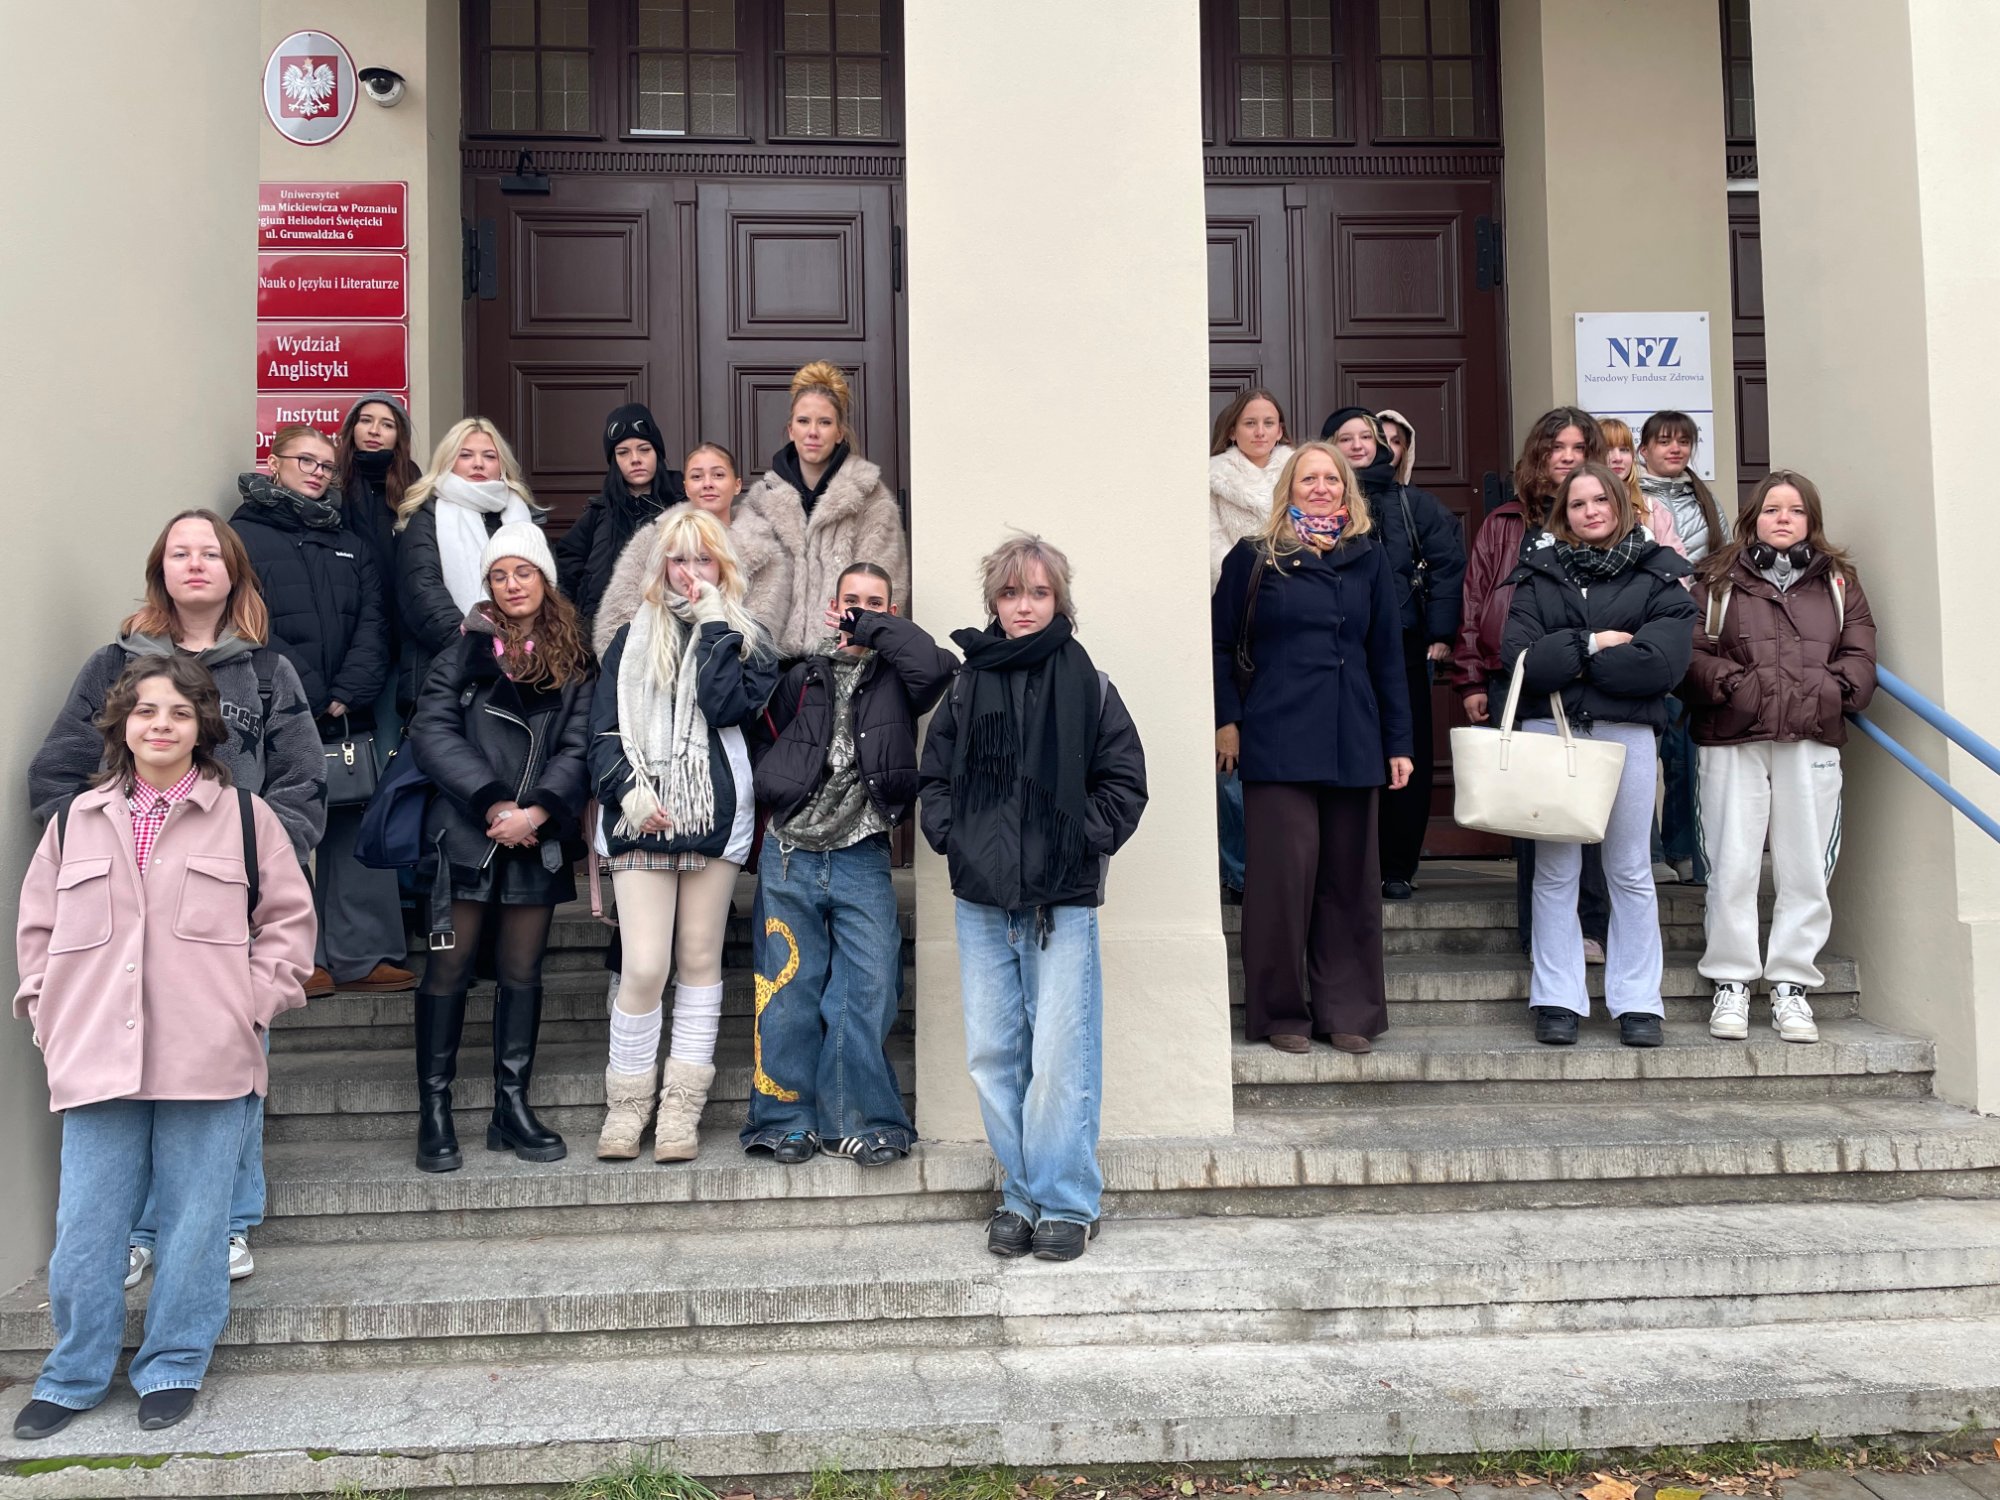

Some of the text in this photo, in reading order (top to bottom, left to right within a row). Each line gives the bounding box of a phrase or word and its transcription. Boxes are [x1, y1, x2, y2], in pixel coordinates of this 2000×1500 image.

[280, 190, 340, 200] Uniwersytet
[278, 203, 338, 212] Mickiewicza
[351, 203, 398, 214] Poznaniu
[287, 216, 334, 225] Heliodori
[336, 214, 383, 228] Święcicki
[265, 229, 354, 239] ul. Grunwaldzka 6
[259, 277, 399, 292] Nauk o Języku i Literaturze
[276, 336, 341, 356] Wydział
[1606, 337, 1682, 368] NFZ
[267, 360, 349, 382] Anglistyki
[1584, 372, 1704, 384] Narodowy Fundusz Zdrowia
[276, 407, 340, 426] Instytut
